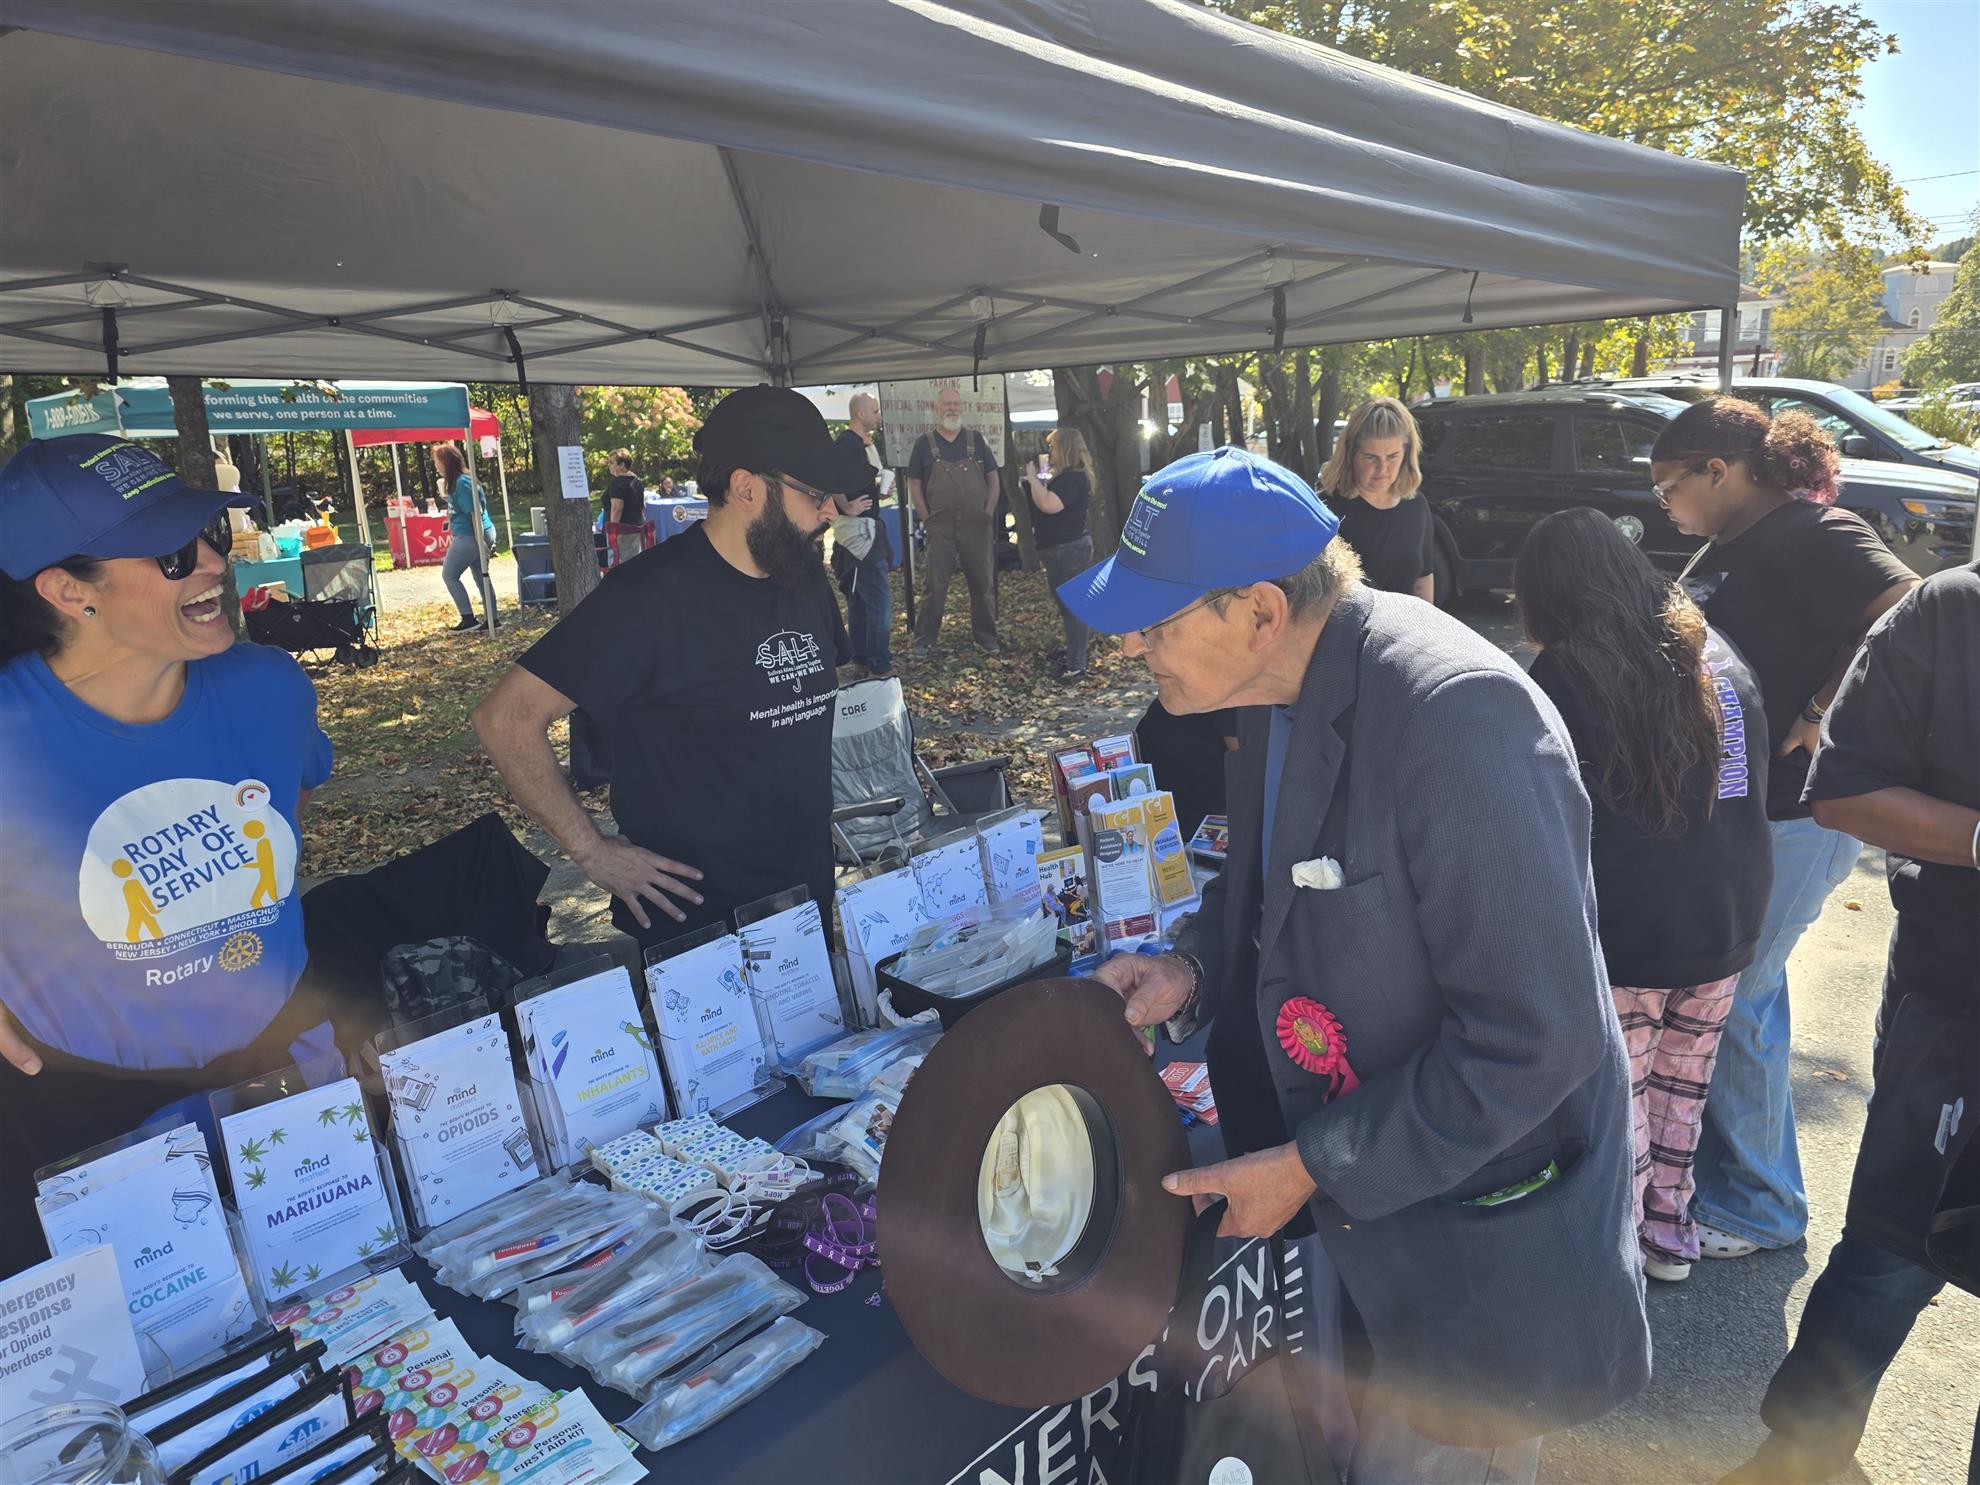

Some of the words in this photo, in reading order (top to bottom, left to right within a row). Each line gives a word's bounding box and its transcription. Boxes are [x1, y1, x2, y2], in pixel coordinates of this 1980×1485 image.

[260, 395, 279, 404] the
[358, 393, 428, 405] communities
[213, 411, 232, 419] we
[235, 411, 273, 421] serve,
[276, 411, 298, 419] one
[301, 410, 340, 422] person
[343, 409, 356, 418] at
[369, 408, 397, 418] time.
[757, 633, 818, 669] SALT
[749, 706, 780, 721] Mental
[781, 700, 805, 714] health
[805, 697, 813, 707] is
[780, 713, 795, 727] any
[841, 702, 867, 717] CORE
[1713, 676, 1750, 800] CHAMPION
[122, 804, 222, 865] ROTARY
[138, 848, 189, 887] DAY
[201, 824, 236, 852] OF
[1039, 863, 1059, 874] Health
[152, 843, 254, 909] SERVICE
[1040, 872, 1053, 881] Hub
[106, 942, 155, 952] BERMUDA
[164, 922, 219, 945] CONNECTICUT
[115, 950, 138, 959] NEW
[140, 945, 171, 958] JERSEY
[178, 937, 197, 948] NEW
[198, 929, 221, 943] YORK
[229, 917, 258, 933] RHODE
[146, 954, 214, 987] Rotary
[778, 957, 800, 973] mind
[700, 1006, 723, 1024] mind
[590, 1047, 616, 1065] mind
[446, 1084, 477, 1106] mind
[577, 1064, 646, 1104] INHALANTS
[437, 1107, 500, 1144] OPIOIDS
[294, 1154, 331, 1179] mind
[266, 1174, 373, 1229] MARIJUANA
[764, 1190, 784, 1199] HOPE
[133, 1241, 175, 1269] mind
[498, 1241, 537, 1254] Toothpaste
[0, 1272, 76, 1321] ergency
[128, 1266, 208, 1315] COCAINE
[0, 1296, 72, 1341] esponse
[10, 1325, 52, 1355] Opioid
[406, 1349, 452, 1373] Personal
[461, 1379, 503, 1408] Personal
[534, 1422, 582, 1450] Personal
[513, 1449, 545, 1473] FIRST
[546, 1437, 568, 1452] AID
[569, 1428, 587, 1441] KIT
